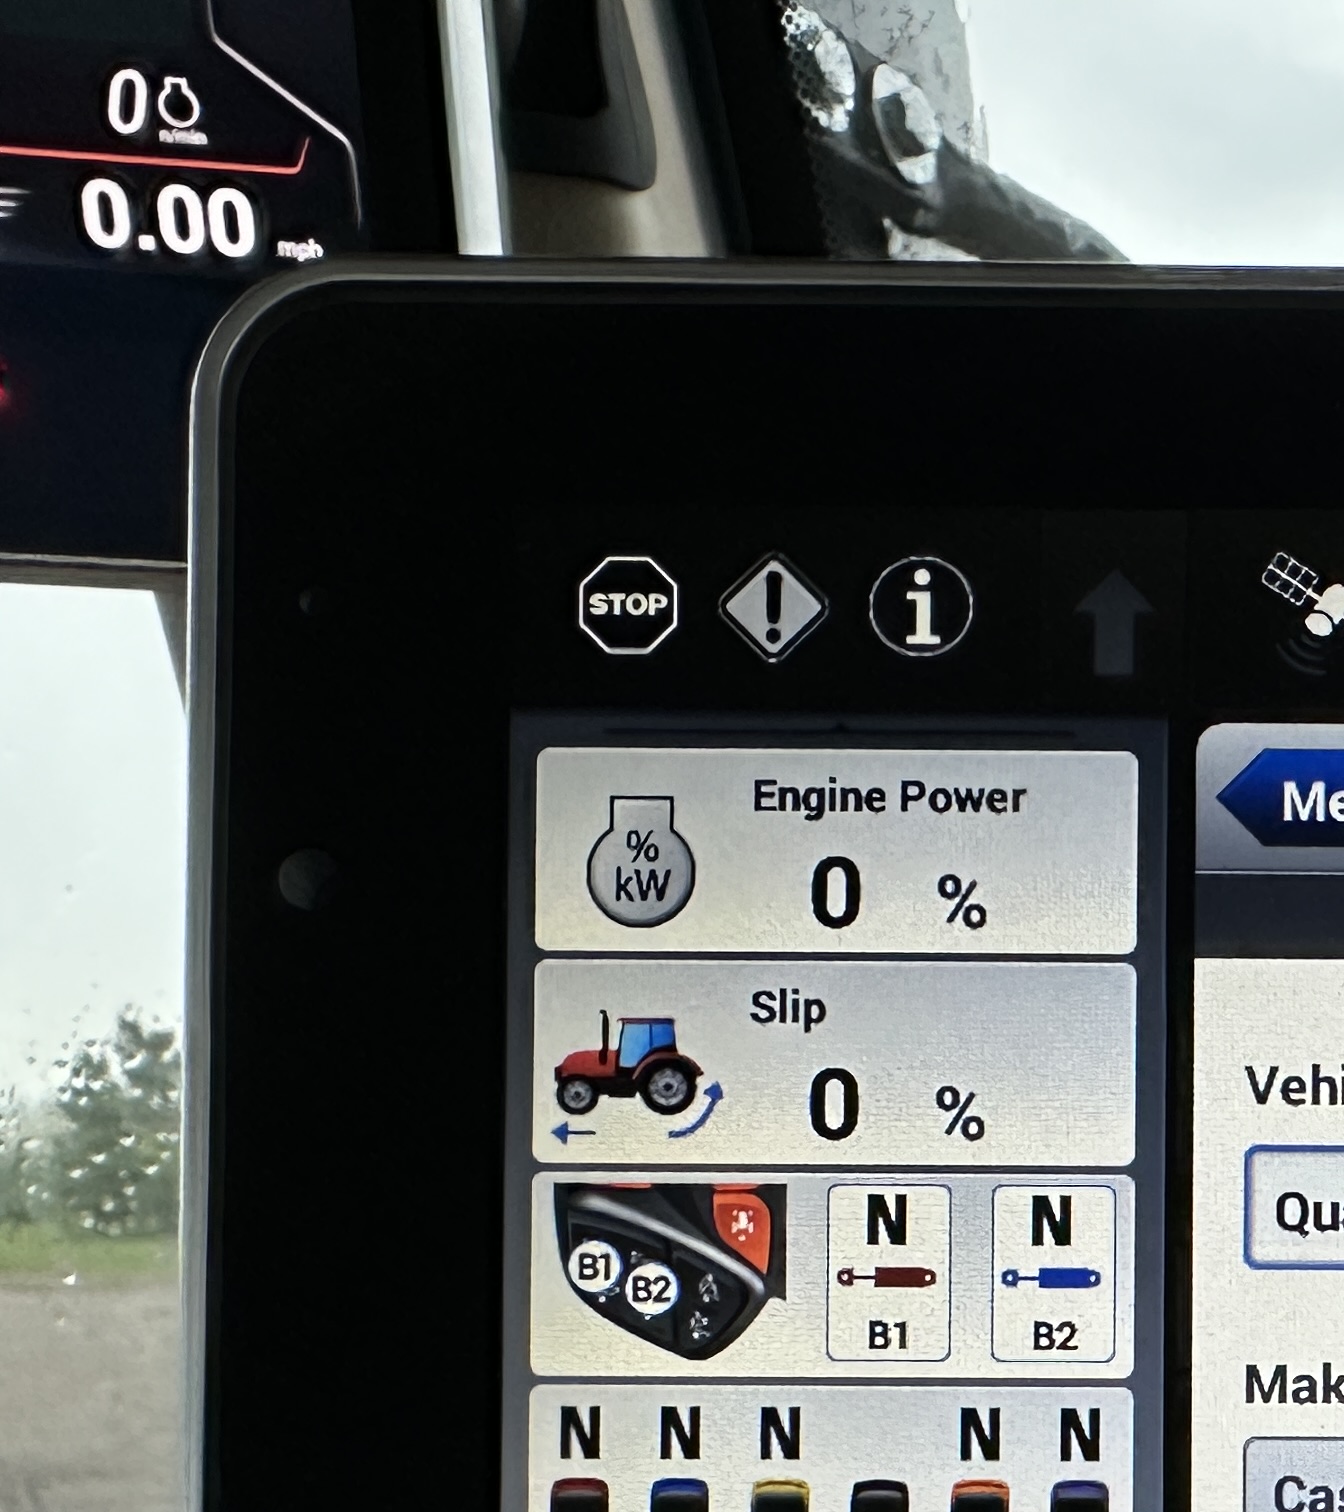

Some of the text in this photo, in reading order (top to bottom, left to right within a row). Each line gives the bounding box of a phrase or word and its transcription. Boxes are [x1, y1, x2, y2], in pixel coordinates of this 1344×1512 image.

[108, 69, 147, 134] 0
[82, 178, 323, 262] 0.00 mph
[589, 593, 668, 615] STOP
[754, 777, 1027, 821] Engine Power
[616, 866, 671, 902] kW
[812, 856, 986, 930] 0 %
[750, 988, 826, 1033] Slip
[810, 1068, 984, 1141] 0 %
[867, 1194, 906, 1245] N
[1032, 1195, 1071, 1246] N
[579, 1253, 611, 1281] B1
[632, 1274, 671, 1303] B2
[869, 1320, 907, 1349] B1
[1034, 1321, 1078, 1350] B2
[560, 1406, 600, 1459] N
[660, 1406, 700, 1459] N
[760, 1407, 800, 1460] N
[961, 1408, 1000, 1461] N
[1061, 1408, 1100, 1461] N
